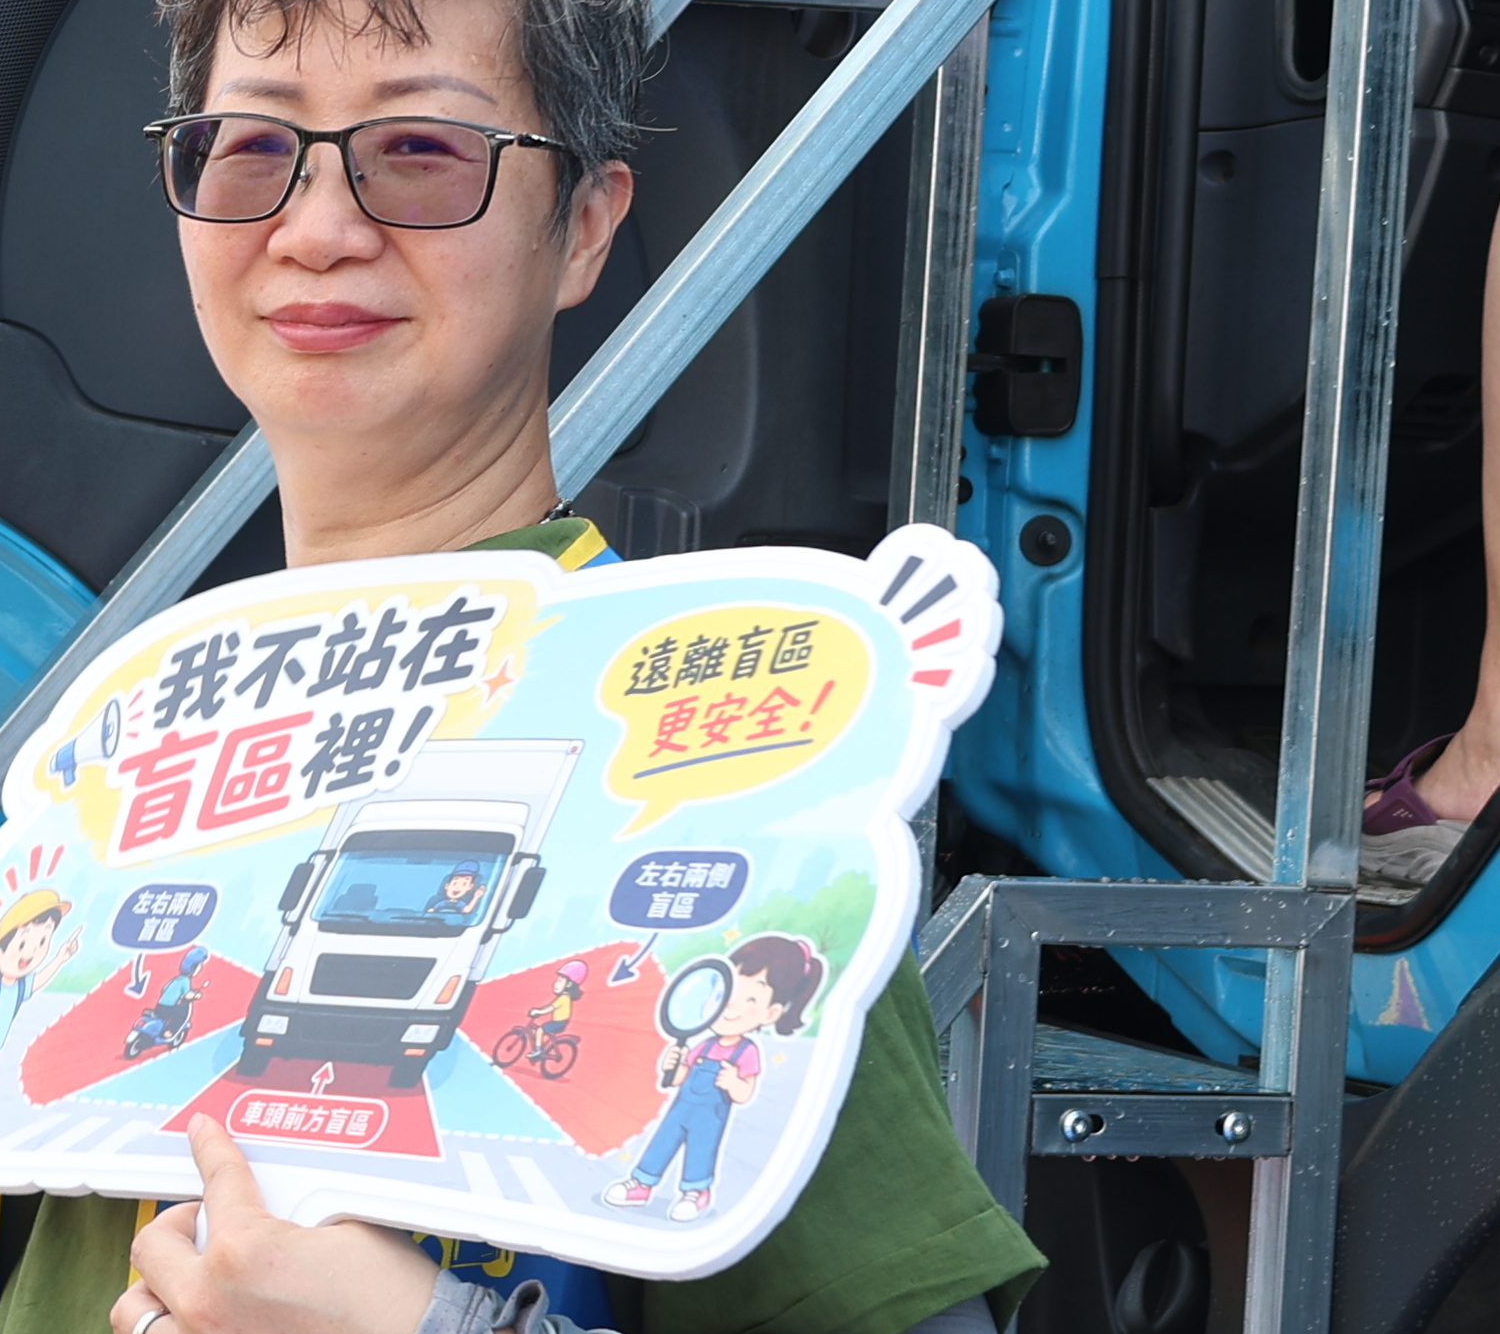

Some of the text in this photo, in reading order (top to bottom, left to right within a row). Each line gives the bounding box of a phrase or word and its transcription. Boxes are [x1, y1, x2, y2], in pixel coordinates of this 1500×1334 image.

[155, 596, 495, 729] 我不站在
[625, 617, 817, 699] 遠離盲區
[651, 680, 835, 754] 更安全!
[117, 703, 430, 855] 盲區裡!
[635, 861, 737, 889] 左右兩側
[132, 890, 210, 916] 左右兩側
[646, 891, 700, 919] 盲區
[138, 917, 179, 942] 盲區
[240, 1100, 374, 1137] 車頭前方盲區
